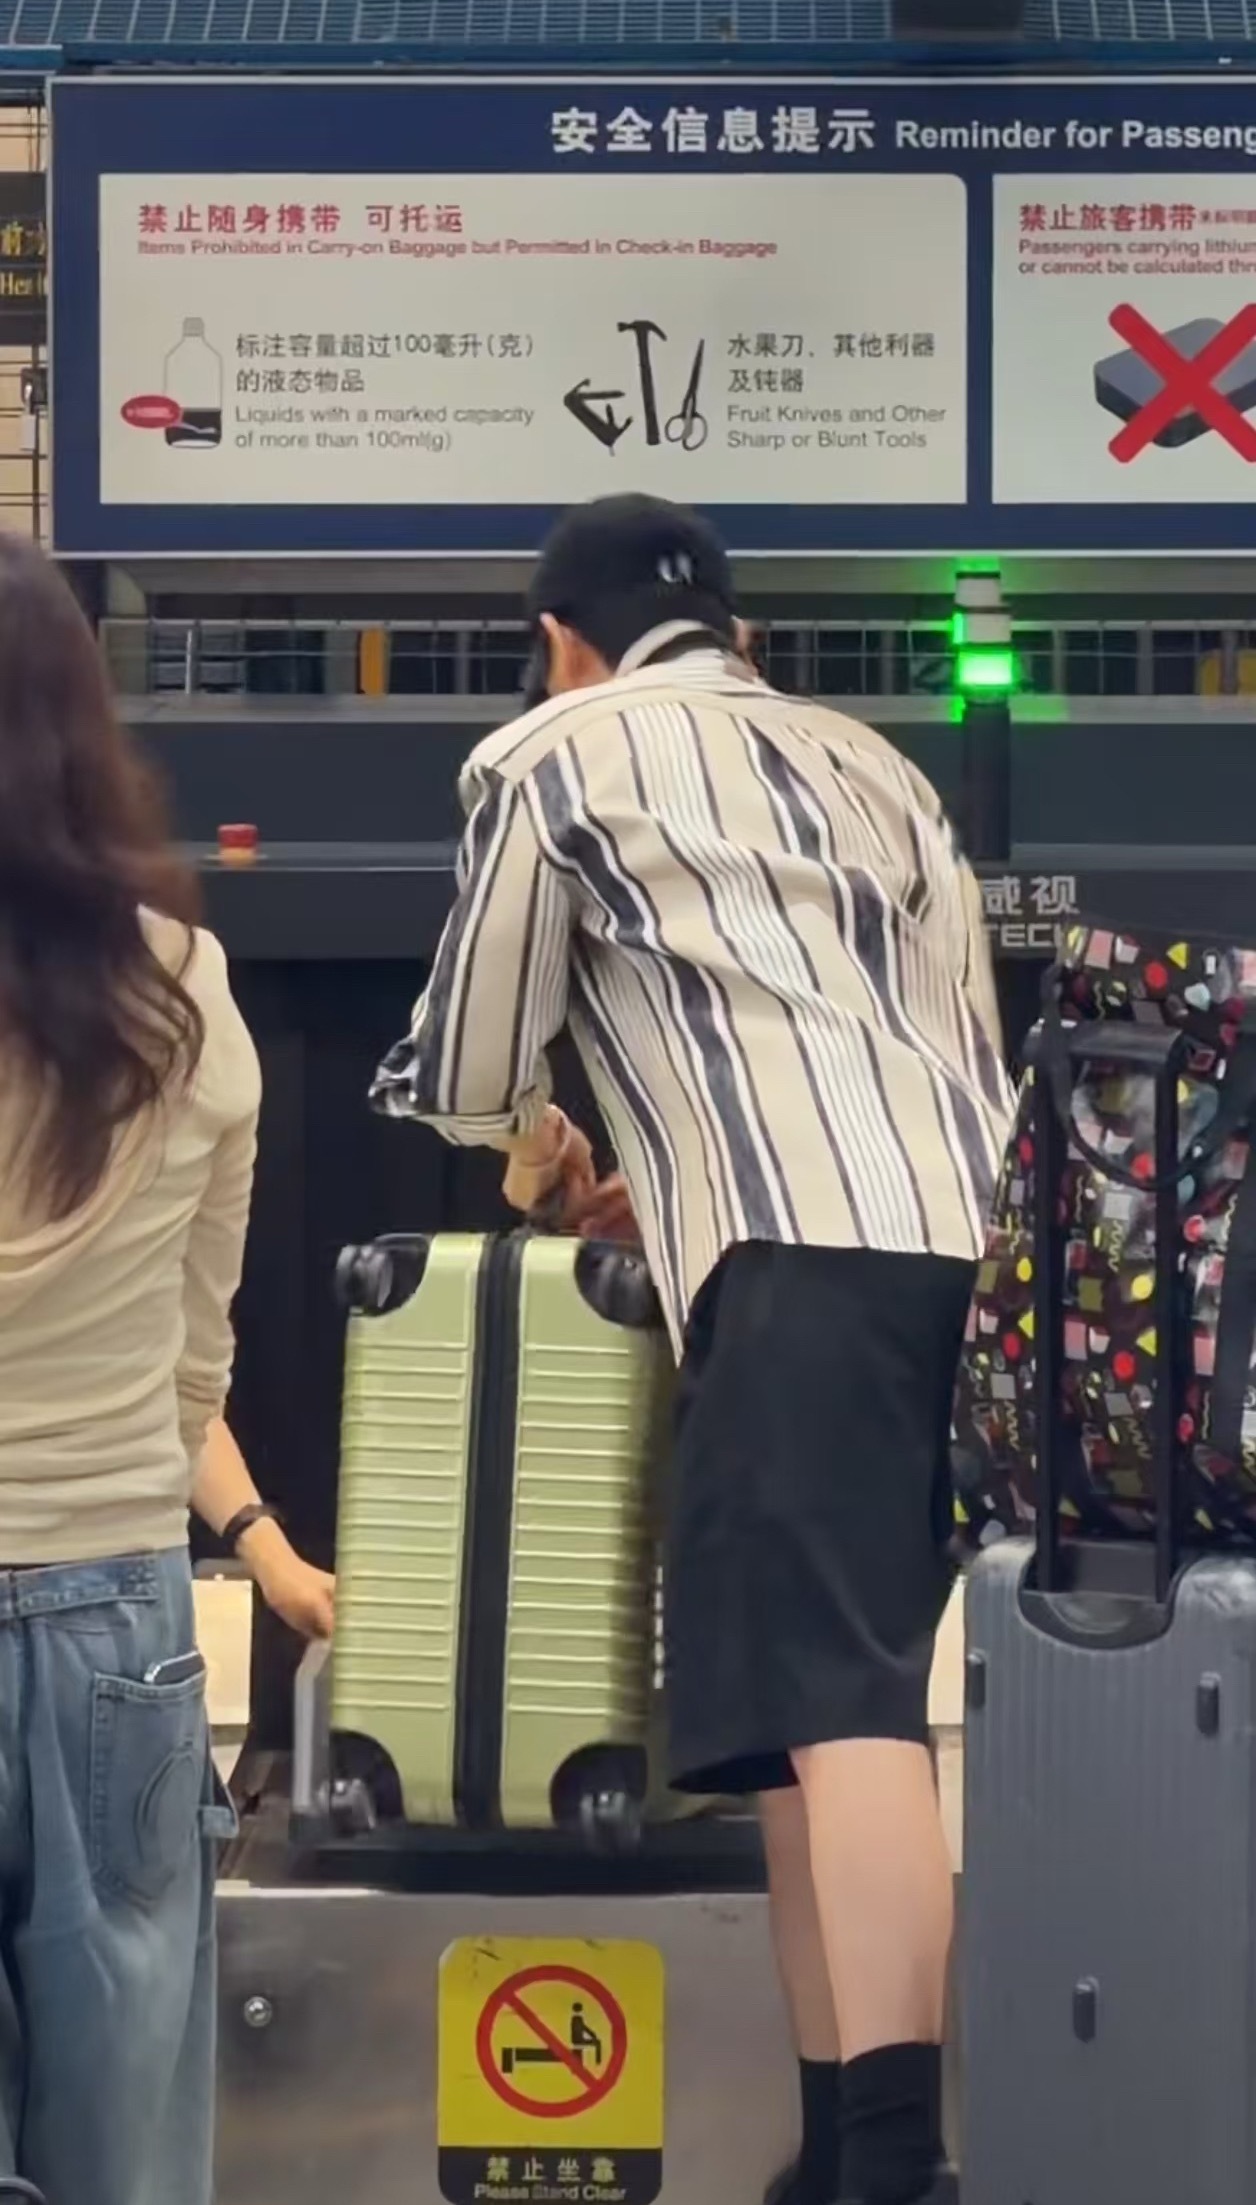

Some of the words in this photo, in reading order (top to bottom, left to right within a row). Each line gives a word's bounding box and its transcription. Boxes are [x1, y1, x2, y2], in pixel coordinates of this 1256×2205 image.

[551, 106, 876, 153] 安全信息提示
[896, 120, 1056, 148] Reminder
[1064, 120, 1112, 148] for
[138, 204, 342, 233] 禁止随身携带
[365, 204, 464, 233] 可托运
[1020, 204, 1196, 232] 禁止旅客携带
[138, 240, 186, 254] Items
[191, 239, 281, 255] Prohibited
[287, 240, 302, 254] in
[307, 239, 382, 257] Carry-on
[389, 239, 467, 258] Baggage
[471, 239, 500, 254] but
[505, 239, 590, 254] Permitted
[616, 239, 694, 255] Check-in
[699, 239, 778, 258] Baggage
[1019, 239, 1122, 257] Passengers
[1127, 240, 1200, 256] carrying
[1018, 262, 1036, 274] or
[1041, 260, 1102, 274] cannot
[1107, 259, 1128, 274] be
[1133, 259, 1223, 275] calculated
[236, 368, 365, 393] 的液态物品
[728, 368, 804, 393] 及钝器
[235, 406, 304, 424] Liquids
[310, 406, 349, 422] with
[356, 409, 368, 422] a
[374, 406, 448, 422] marked
[453, 406, 535, 426] capacity
[728, 405, 771, 422] Fruit
[778, 405, 842, 422] Knives
[850, 405, 886, 422] and
[892, 404, 947, 422] Other
[235, 432, 253, 448] of
[259, 434, 309, 448] more
[316, 432, 358, 448] than
[728, 430, 786, 451] Sharp
[791, 434, 811, 448] or
[817, 430, 868, 448] Blunt
[875, 430, 928, 448] Tools
[474, 2184, 530, 2199] Please
[582, 2184, 627, 2200] Clear
